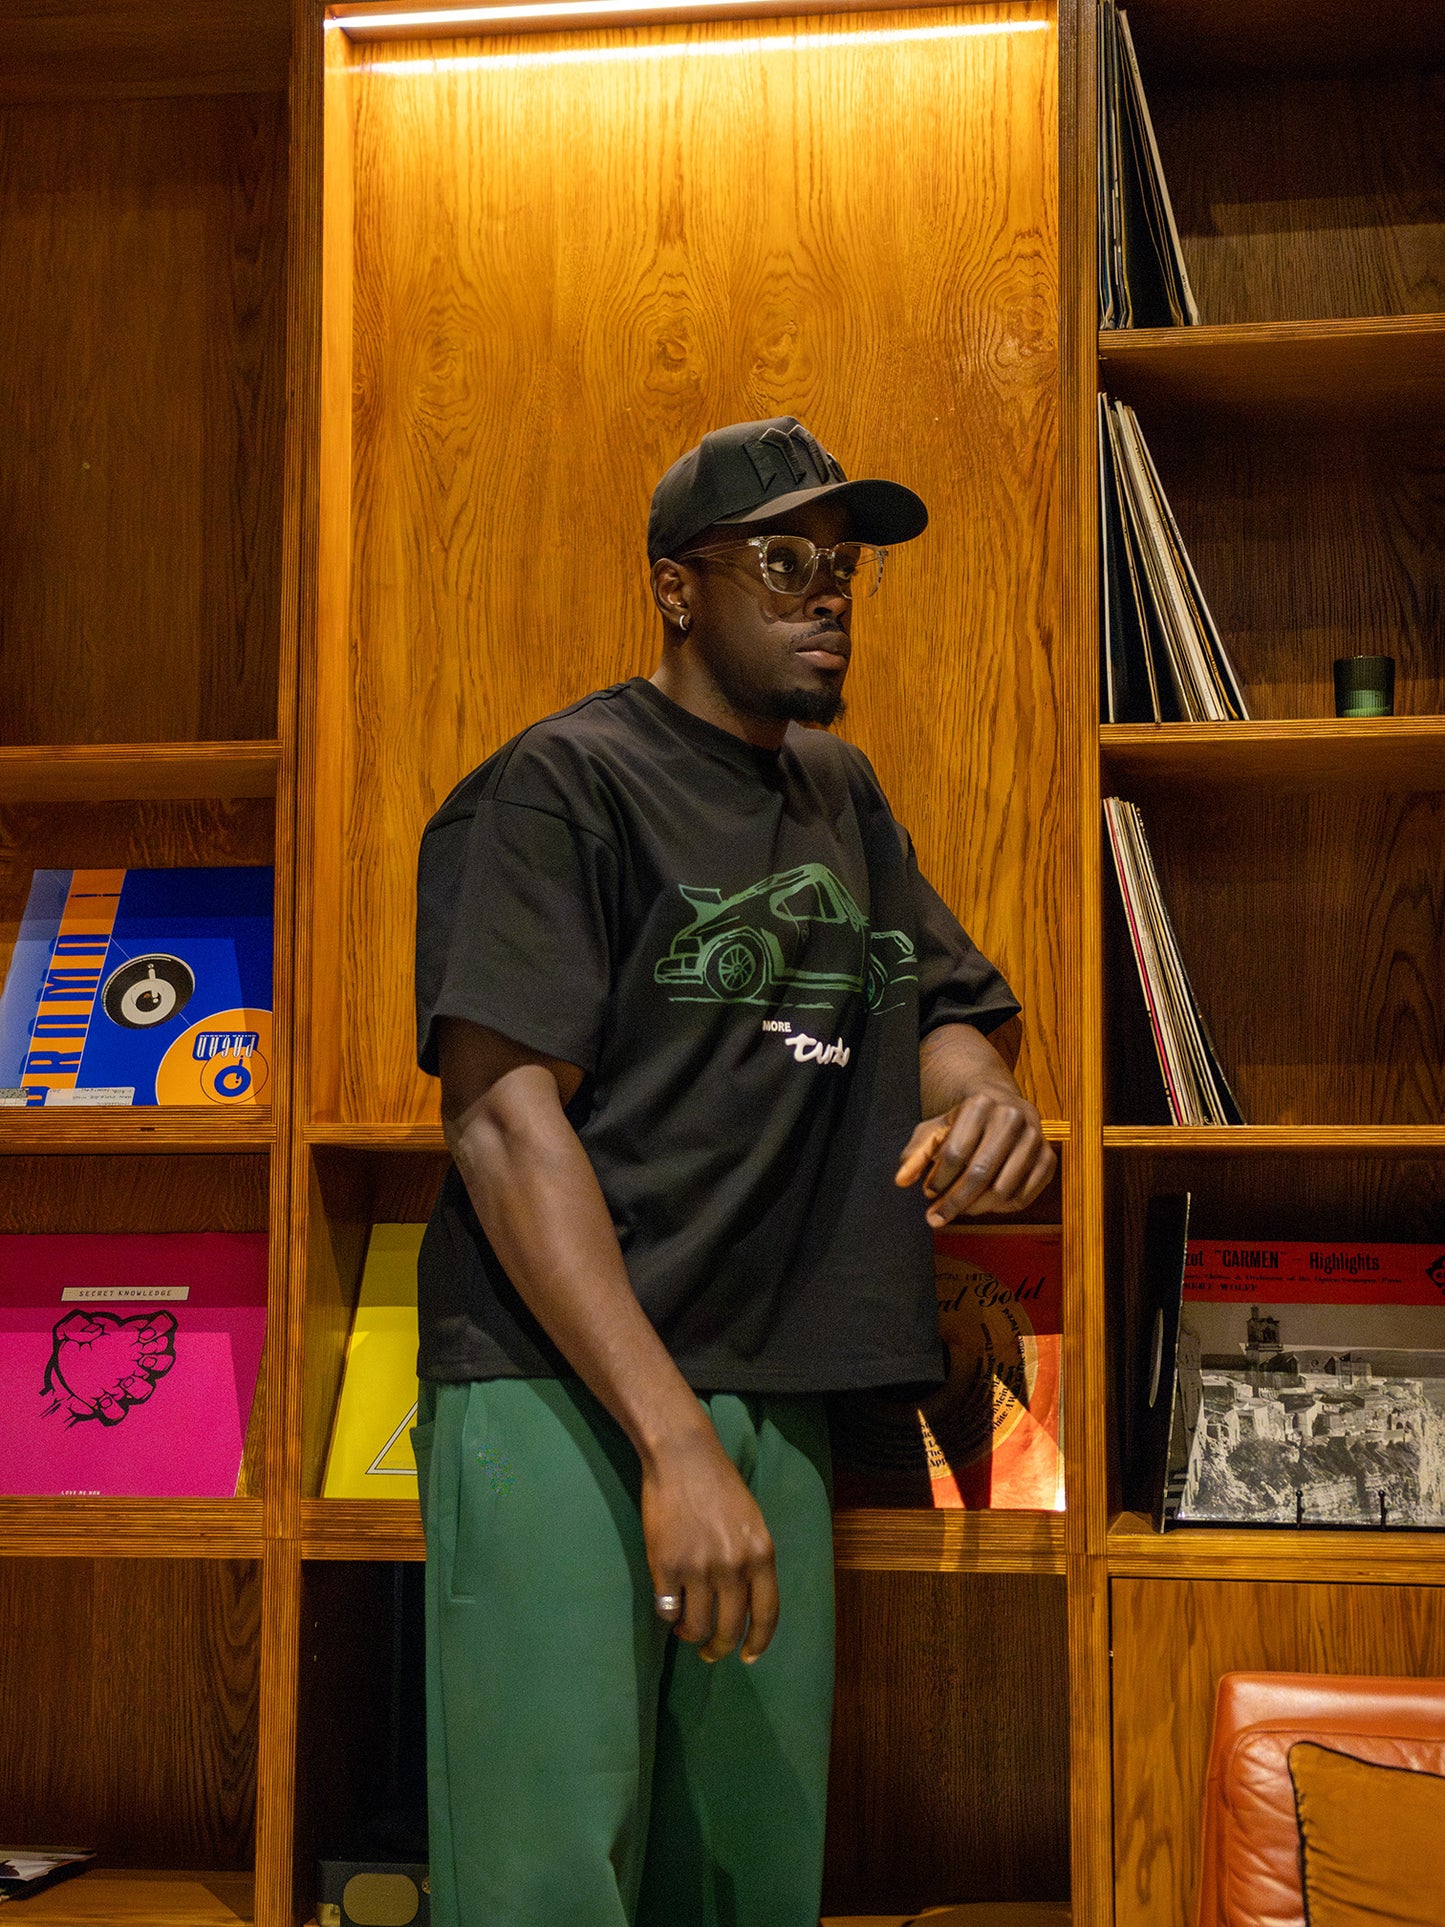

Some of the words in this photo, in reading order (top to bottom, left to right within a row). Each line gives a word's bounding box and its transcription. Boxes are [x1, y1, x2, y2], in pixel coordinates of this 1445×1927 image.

[762, 1020, 792, 1033] MORE
[197, 1037, 256, 1058] PAGAN
[1310, 1251, 1379, 1275] Highlights
[118, 1289, 172, 1297] KNOWLEDGE
[974, 1276, 1046, 1308] Gold
